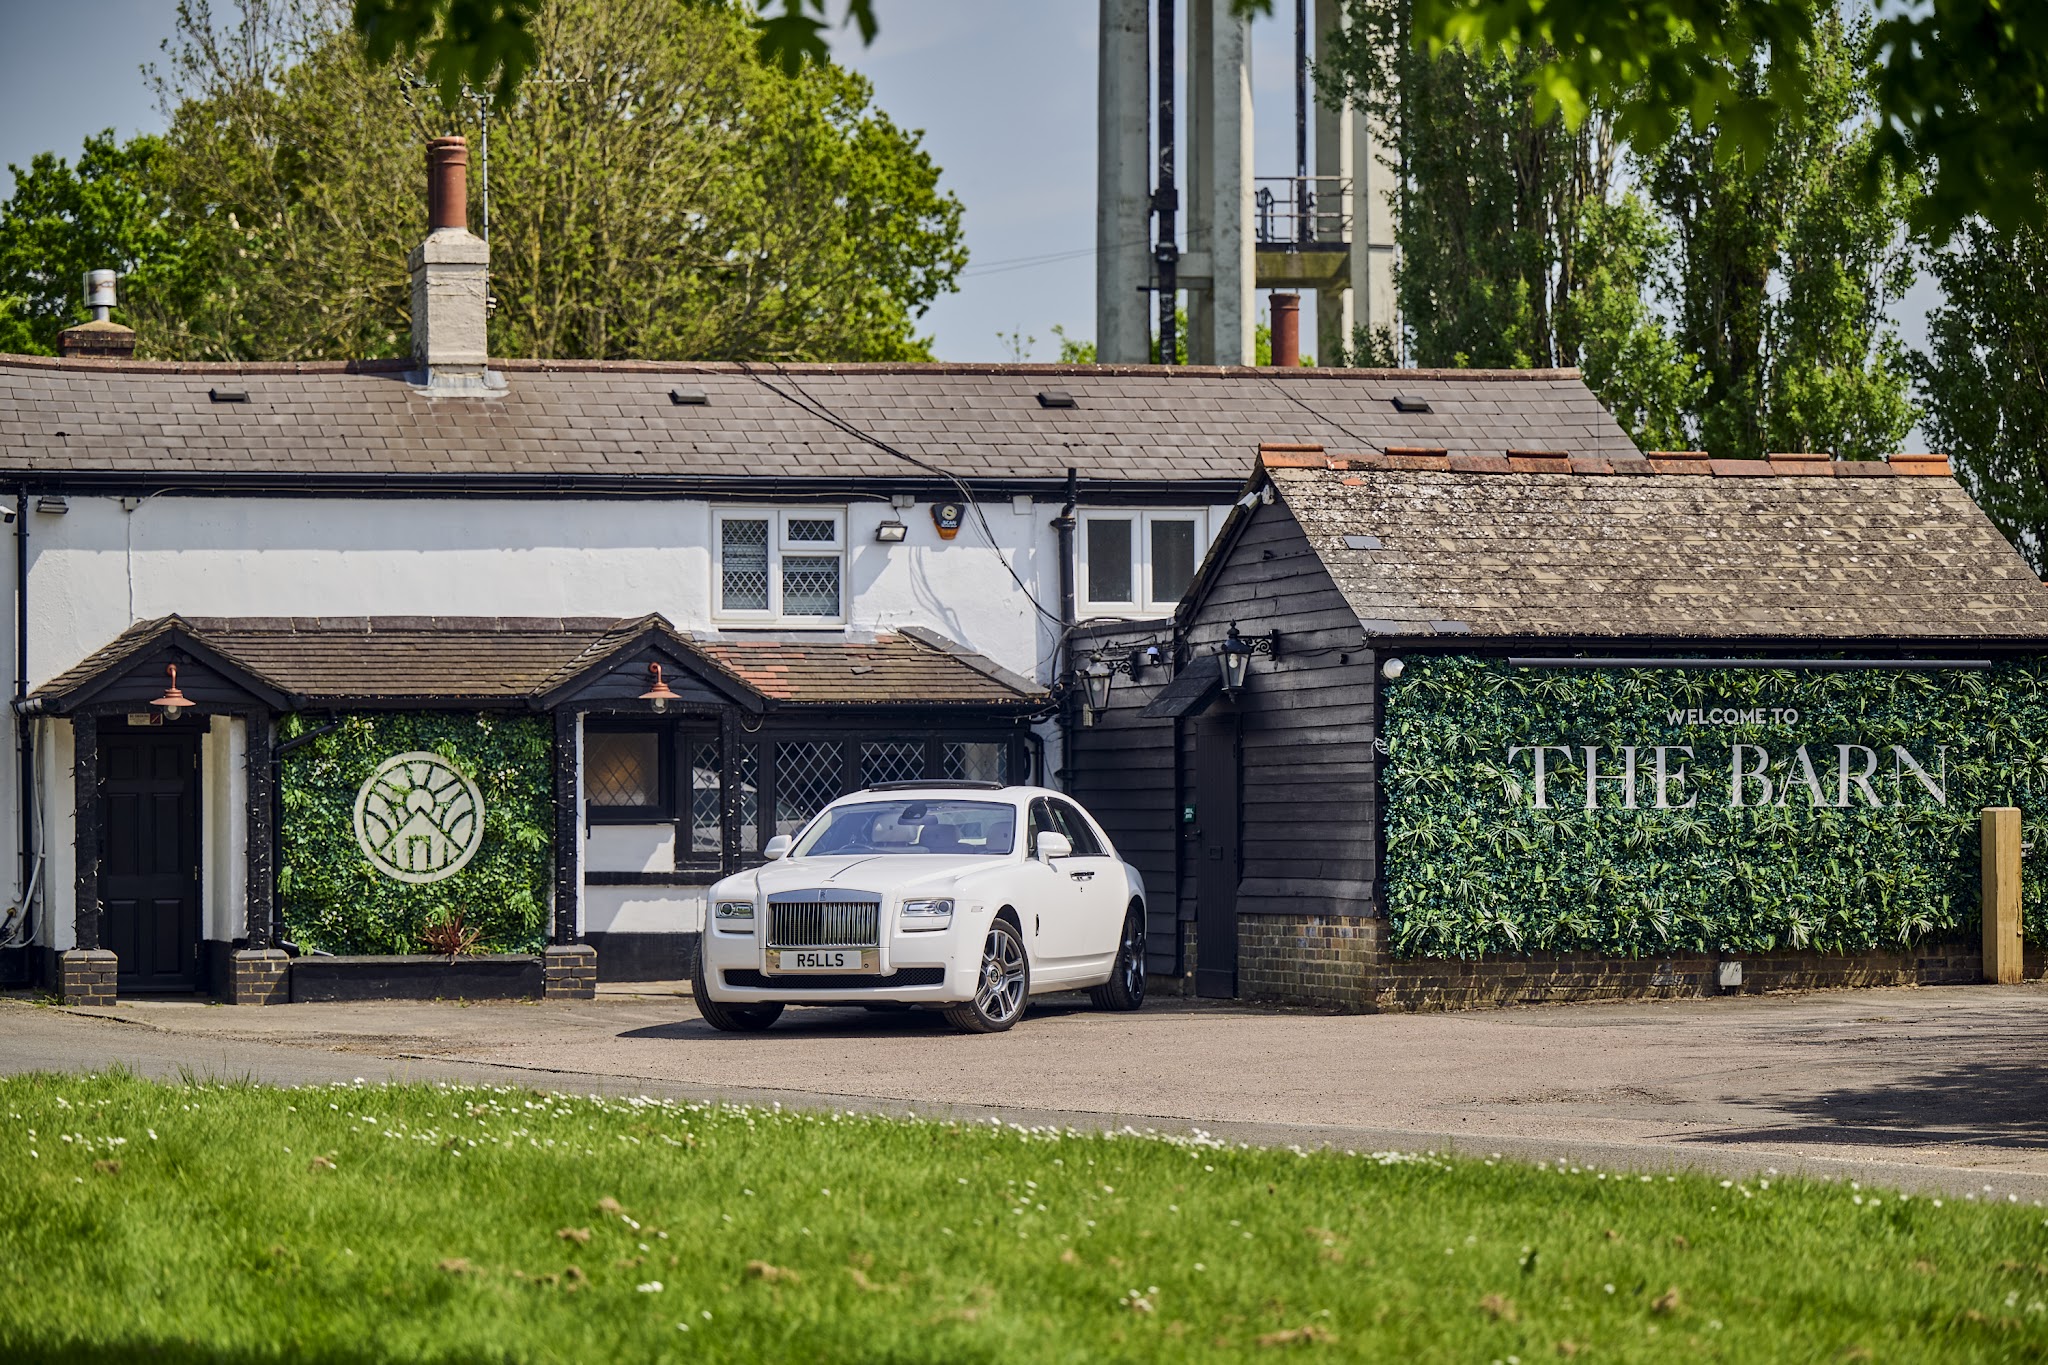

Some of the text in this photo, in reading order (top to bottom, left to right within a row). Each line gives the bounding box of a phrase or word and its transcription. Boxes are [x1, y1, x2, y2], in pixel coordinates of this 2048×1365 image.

[1667, 708, 1799, 725] WELCOME TO
[1507, 744, 1950, 809] THE BARN
[797, 953, 844, 967] R5LLS
